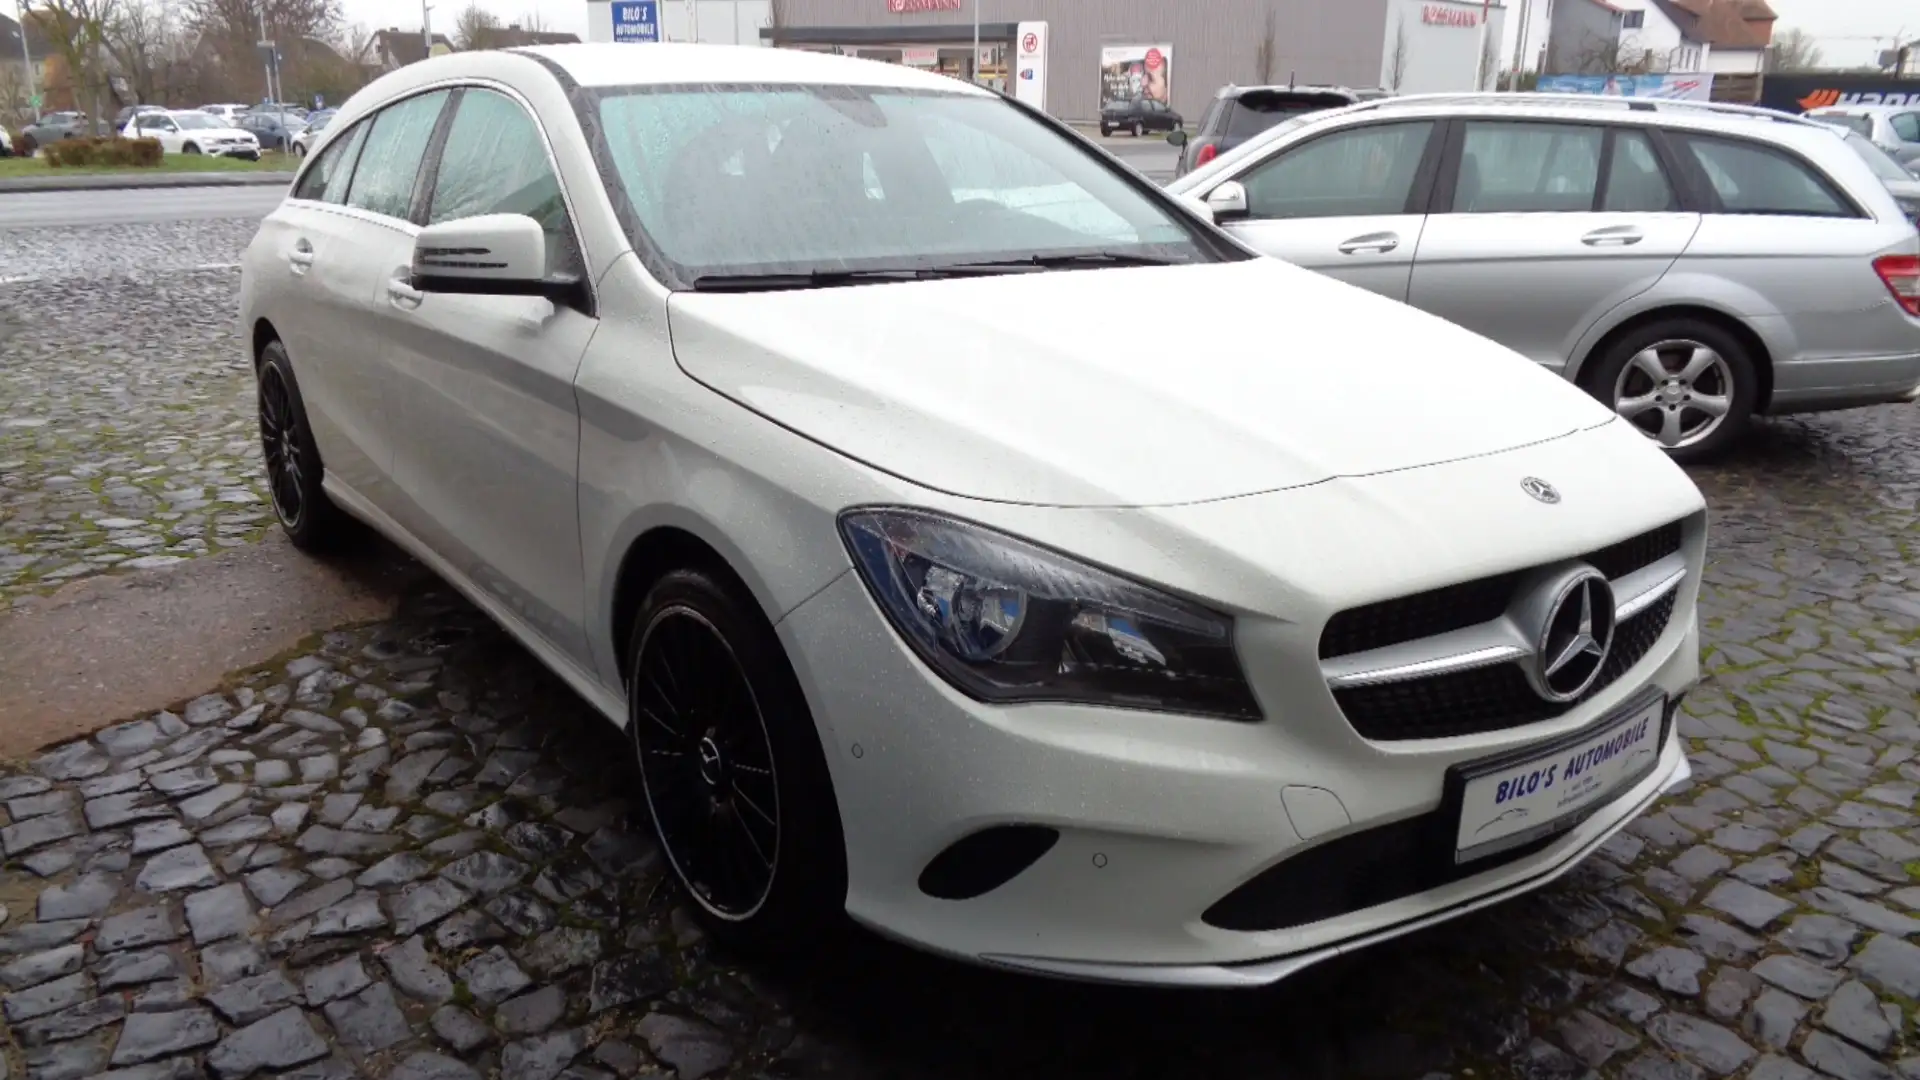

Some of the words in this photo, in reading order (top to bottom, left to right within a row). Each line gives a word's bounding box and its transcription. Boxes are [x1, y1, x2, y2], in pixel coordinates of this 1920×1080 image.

[622, 6, 648, 21] BILO'S
[616, 23, 655, 36] AUTOMOBILE
[1495, 763, 1558, 805] BILO'S
[1563, 716, 1649, 780] AUTOMOBILE
